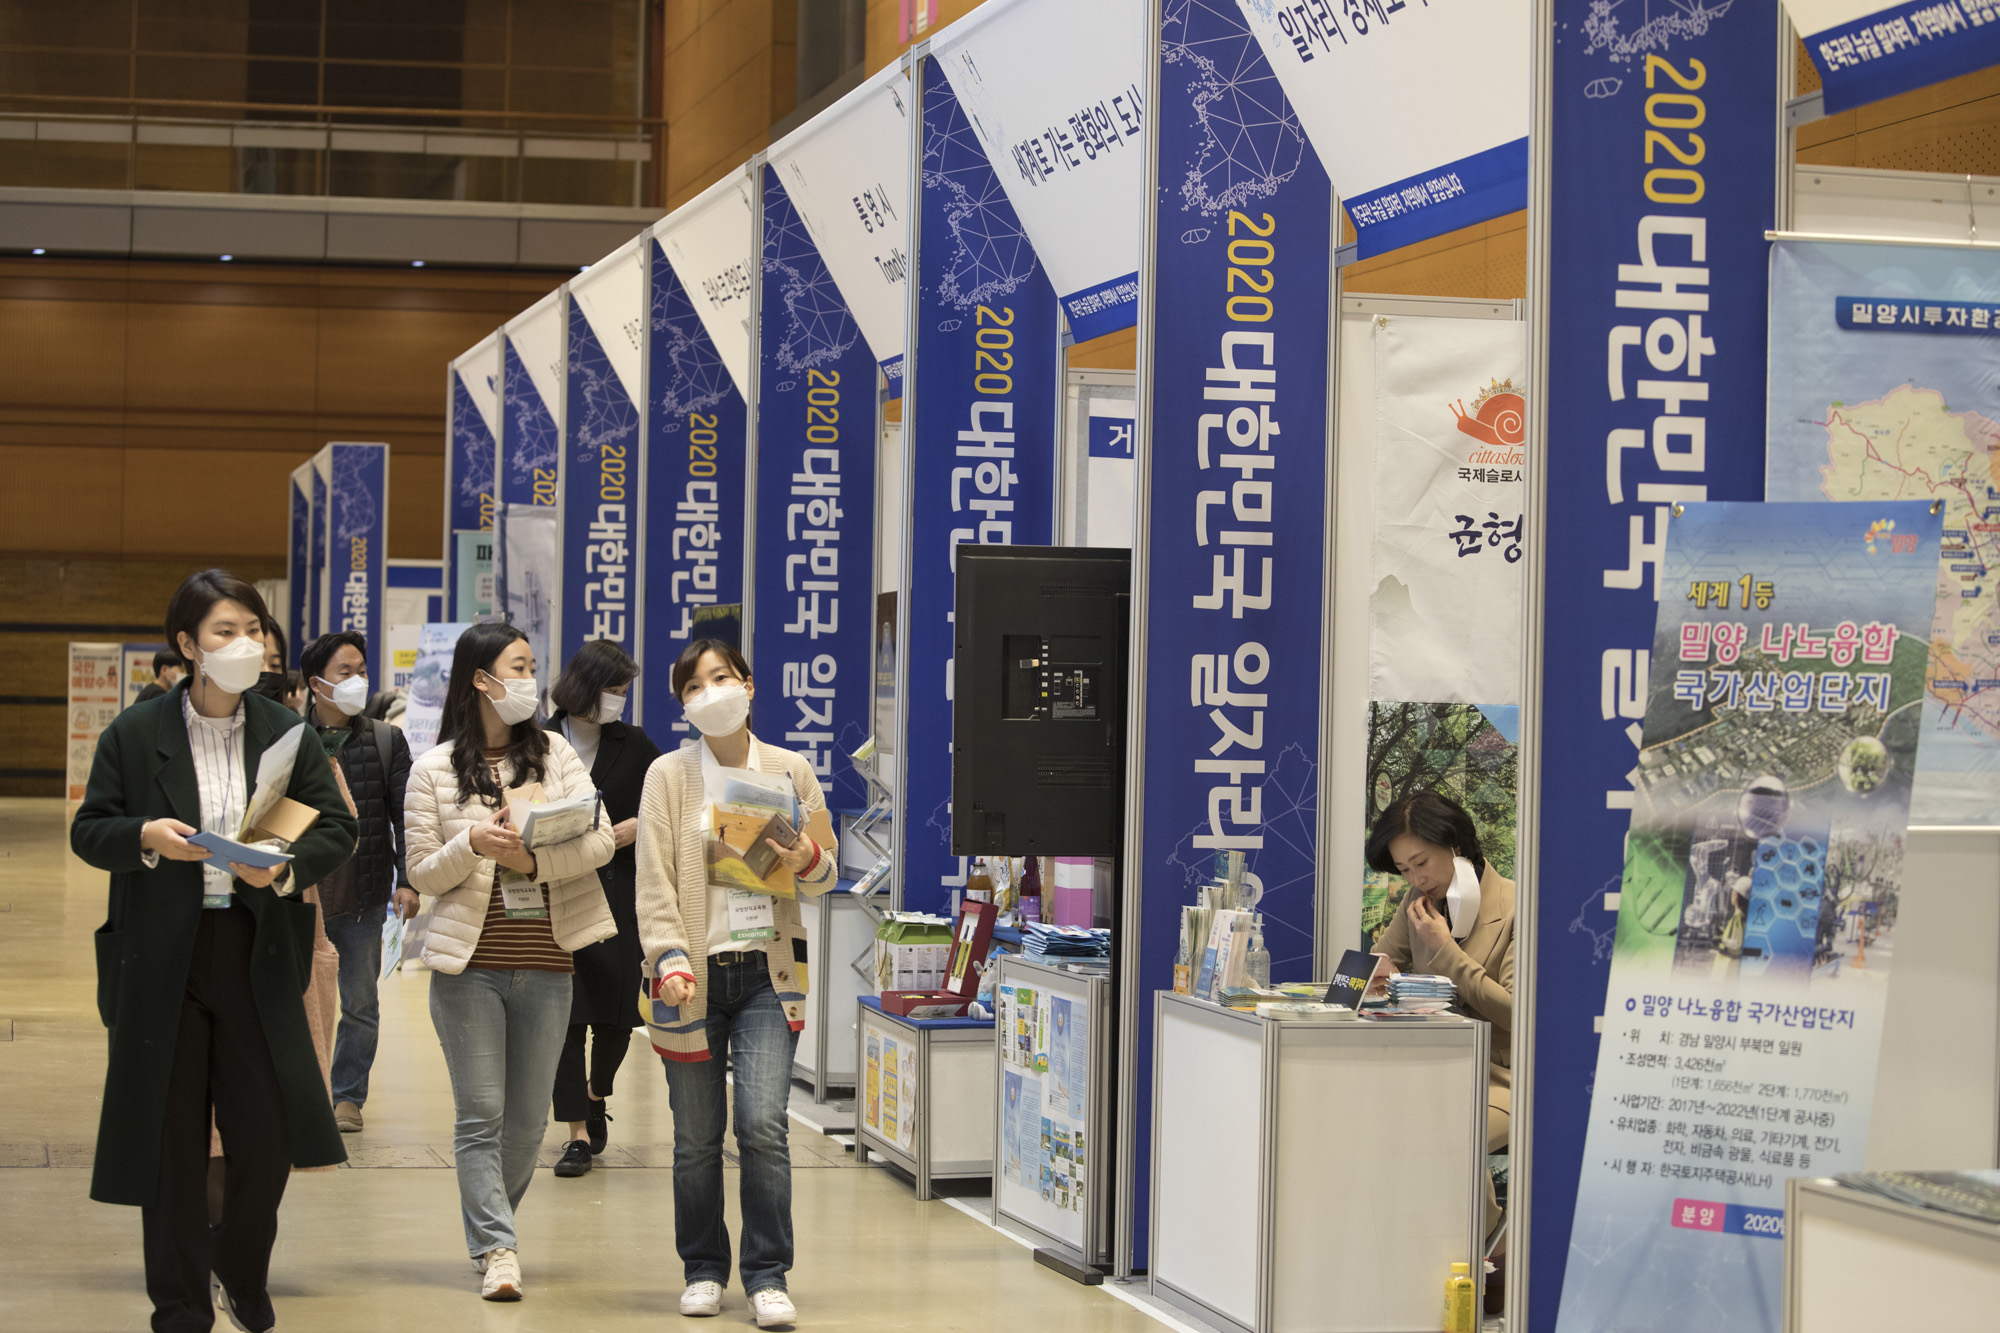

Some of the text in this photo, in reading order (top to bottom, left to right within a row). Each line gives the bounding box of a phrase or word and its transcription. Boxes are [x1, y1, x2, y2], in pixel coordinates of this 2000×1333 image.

[1819, 35, 1859, 72] 한국판
[1850, 27, 1882, 61] 뉴딜
[1910, 1, 1968, 40] 지역에서
[1960, 0, 2000, 27] 앞장
[1011, 138, 1054, 187] 세계로
[1043, 127, 1080, 172] 가는
[1068, 100, 1124, 161] 평화의
[1644, 55, 1706, 204] 2020
[853, 183, 897, 233] 통영시
[1352, 202, 1376, 227] 한국판
[1368, 198, 1388, 222] 뉴딜
[1400, 183, 1432, 210] 지역에서
[1426, 172, 1466, 203] 앞장섭니다
[1226, 211, 1275, 322] 2020
[975, 305, 1014, 394] 2020
[806, 369, 840, 443] 2020
[689, 413, 718, 476] 2020
[1109, 424, 1132, 453] 거
[1193, 331, 1281, 619] 대한민국
[351, 537, 368, 570] 2020
[583, 445, 629, 642] 2020 대한민국
[784, 449, 844, 640] 대한민국
[1687, 573, 1775, 609] 세계 1등
[1680, 622, 1898, 665] 밀양 나노융합
[1674, 671, 1891, 712] 국가산업단지
[1191, 642, 1270, 849] 일자리
[737, 931, 767, 939] EXHIBITOR
[1643, 995, 1855, 1030] 밀양 나노융합 국가산업단지
[1680, 1033, 1700, 1047] 경남
[1704, 1034, 1736, 1050] 밀양시
[1740, 1038, 1774, 1054] 부북면
[1779, 1040, 1802, 1057] 일원
[1660, 1162, 1772, 1189] 한국토지주택공사(LH)
[1691, 1143, 1724, 1159] 비금속
[1759, 1150, 1794, 1167] 식료품
[1799, 1154, 1811, 1169] 등
